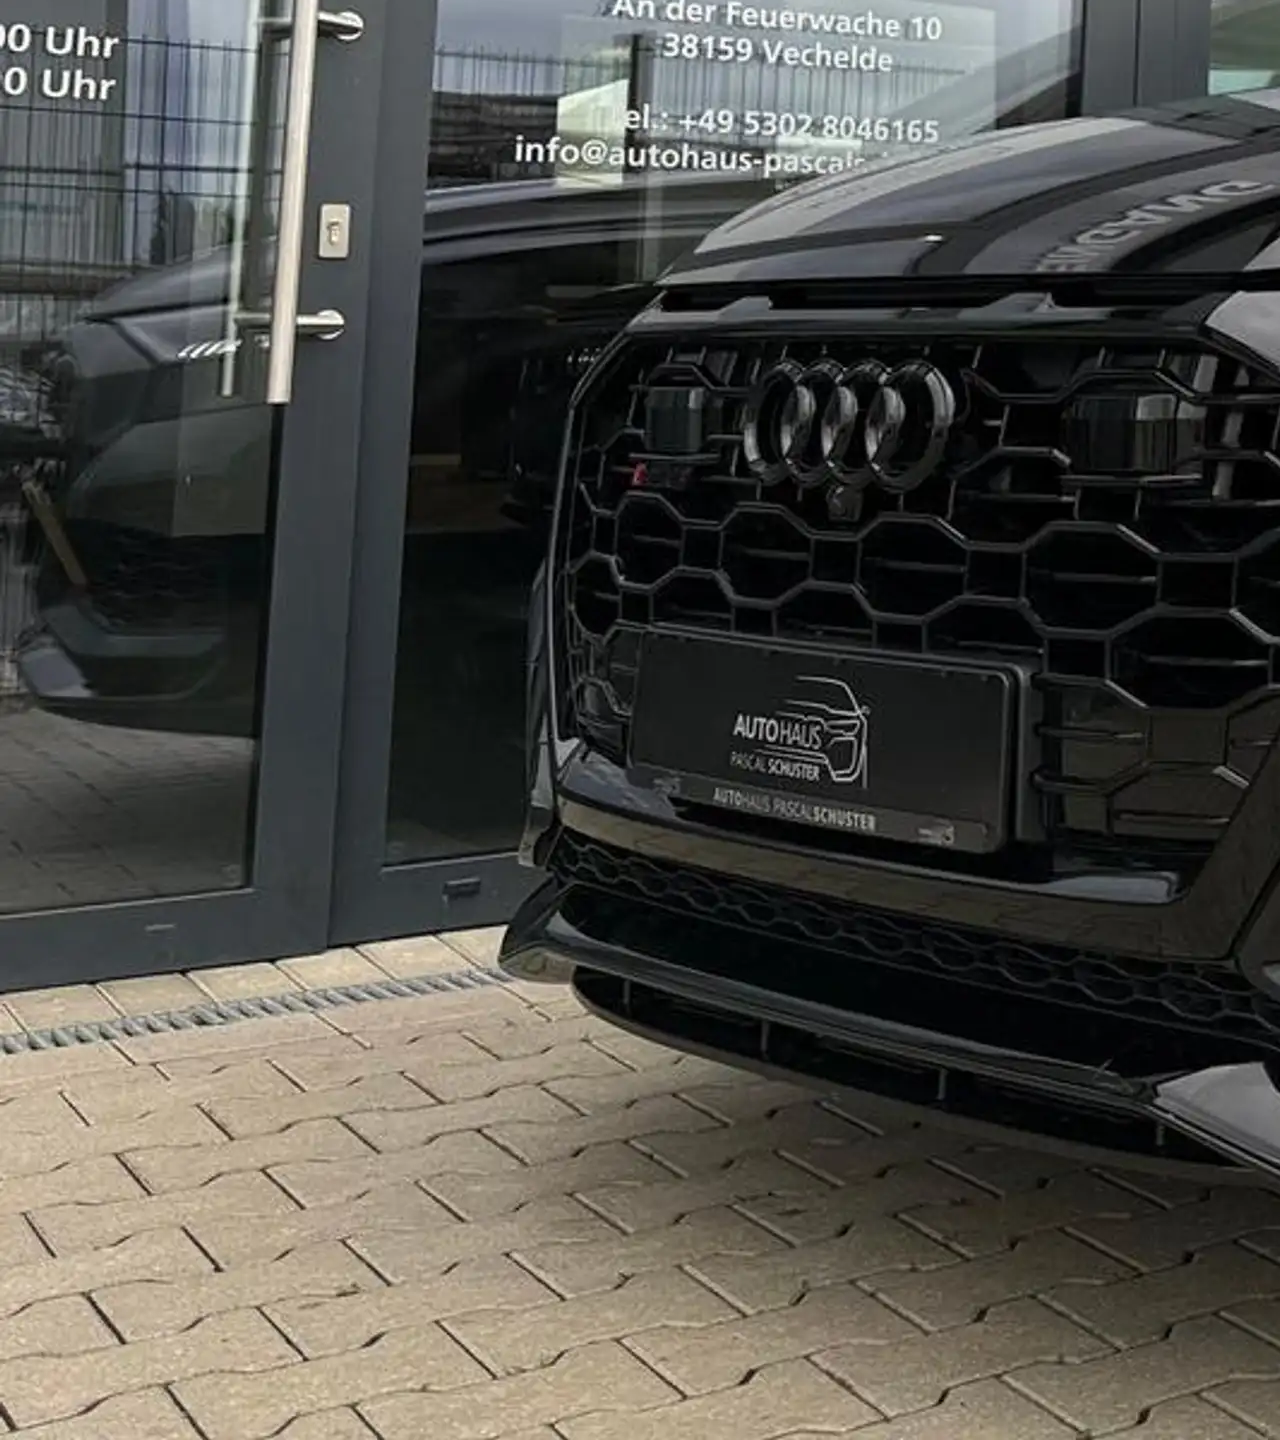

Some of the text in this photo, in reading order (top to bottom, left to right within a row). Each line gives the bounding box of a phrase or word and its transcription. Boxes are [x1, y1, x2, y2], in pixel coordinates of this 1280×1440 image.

[726, 0, 900, 38] Feuerwache
[911, 16, 942, 40] 10
[0, 23, 119, 58] 0 Uhr
[662, 32, 893, 72] 38159 Vechelde
[0, 66, 117, 101] 0 Uhr
[617, 102, 940, 143] el.: +49 5302 8046165
[732, 712, 822, 750] AUTOHAUS
[730, 751, 820, 782] PASCAL SCHUSTER
[713, 787, 770, 813] AUTOHAUS
